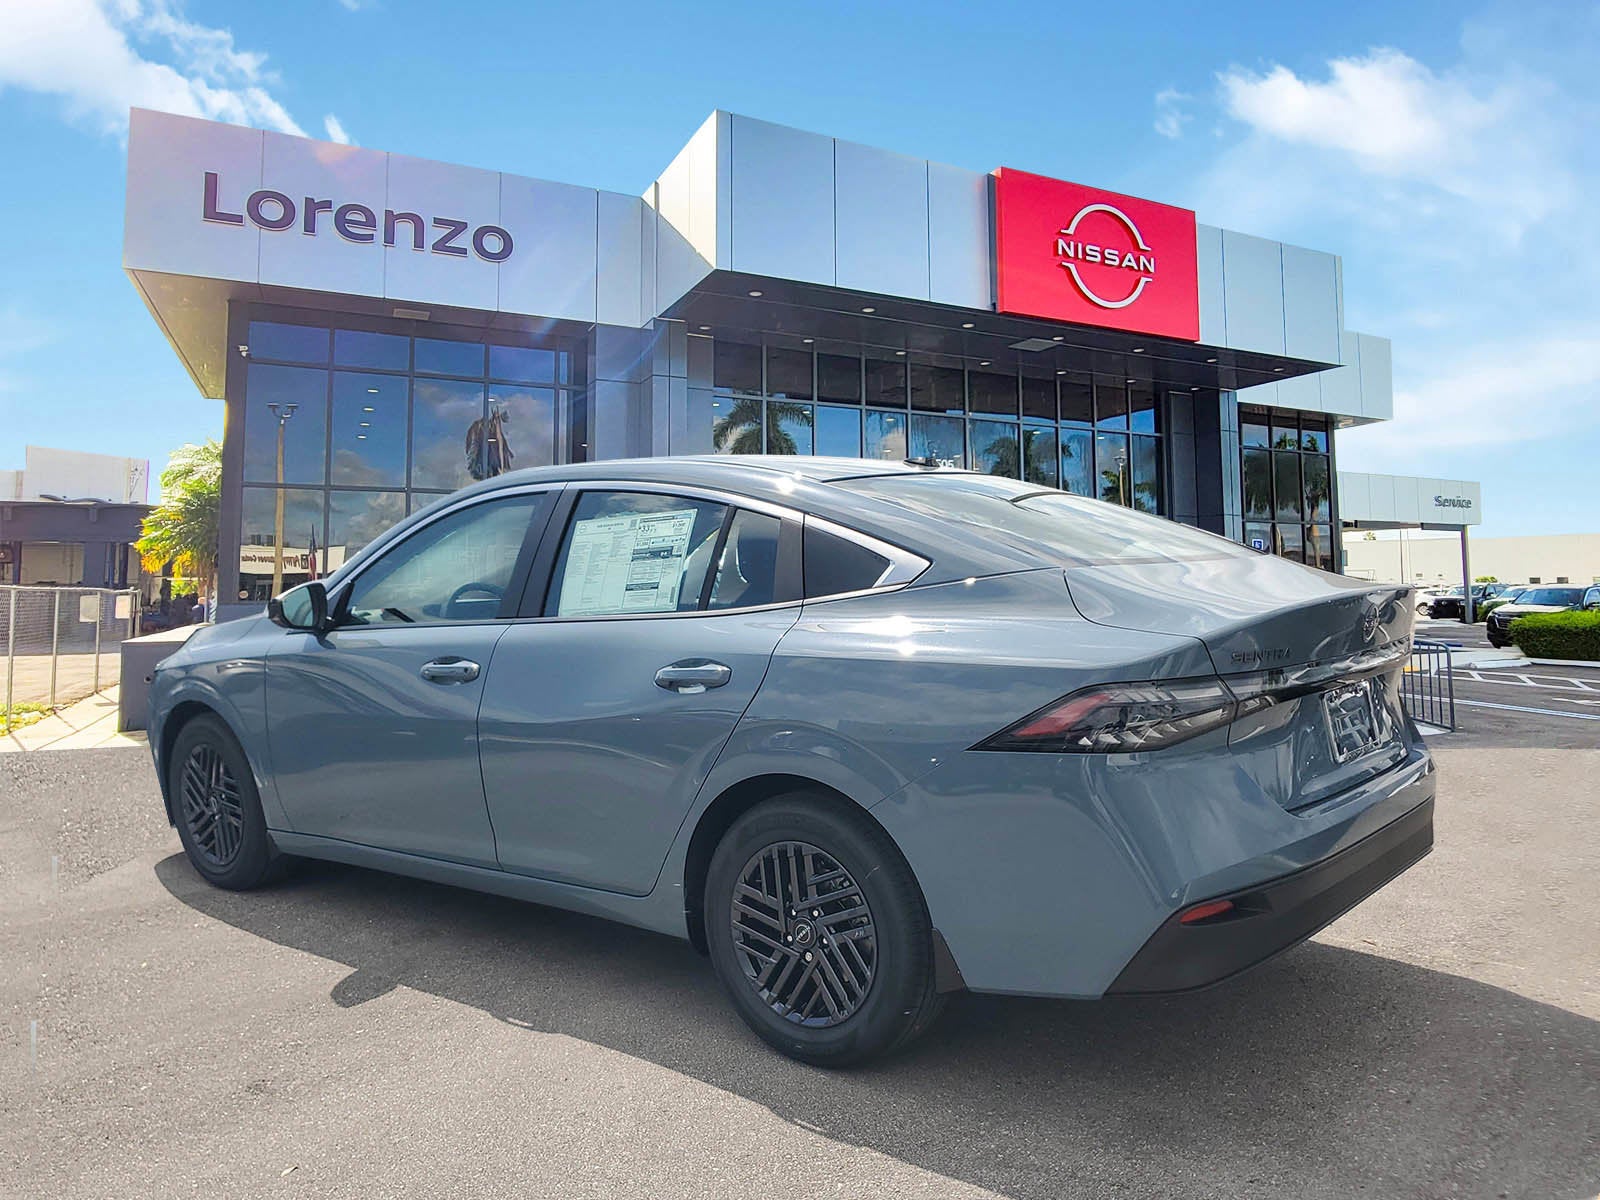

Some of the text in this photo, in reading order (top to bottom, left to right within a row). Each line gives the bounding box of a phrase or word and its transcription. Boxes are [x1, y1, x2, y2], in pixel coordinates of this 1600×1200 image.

[202, 171, 514, 262] Lorenzo
[1057, 238, 1155, 273] NISSAN
[1434, 495, 1472, 509] Service
